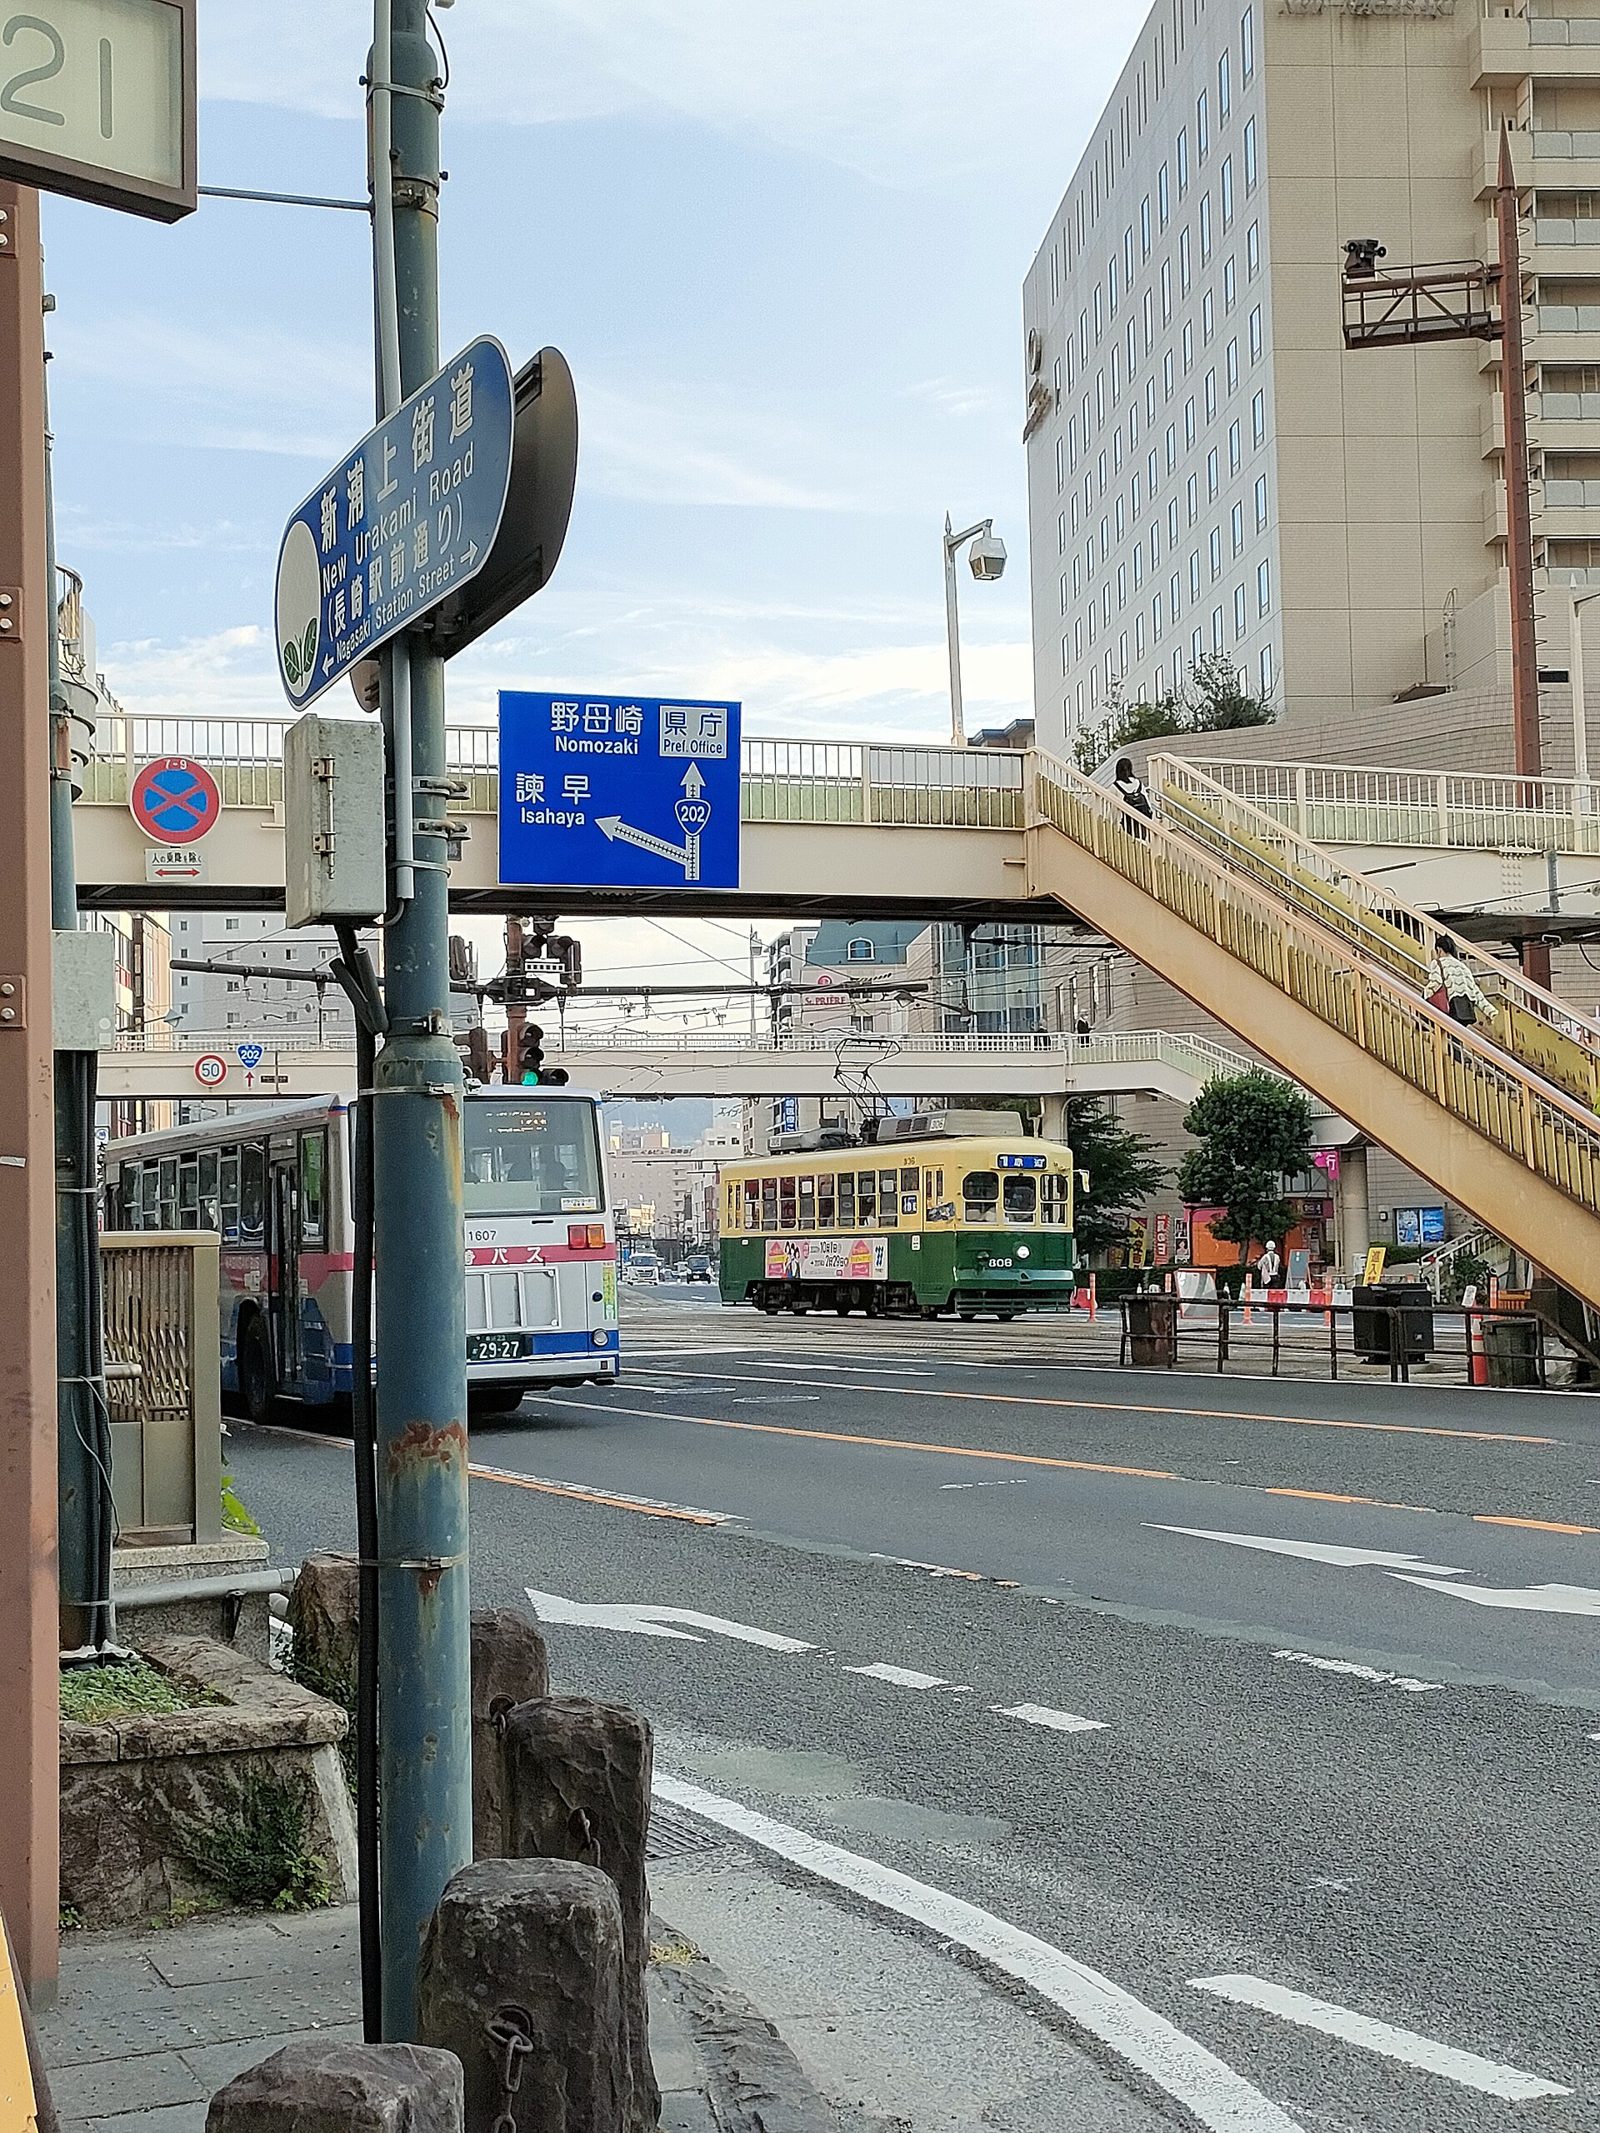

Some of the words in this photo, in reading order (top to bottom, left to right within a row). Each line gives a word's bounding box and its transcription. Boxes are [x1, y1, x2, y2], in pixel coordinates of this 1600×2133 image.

[1, 14, 113, 139] 21
[320, 362, 474, 555] 新浦上街道
[323, 553, 347, 598] New
[355, 487, 417, 566] Urakami
[429, 441, 473, 504] Road
[336, 614, 371, 664] Nagasaki
[375, 588, 413, 630] Station
[418, 556, 455, 598] Street
[551, 702, 644, 736] 野母崎
[664, 711, 723, 737] 県庁
[555, 735, 639, 755] Nomozaki
[516, 773, 591, 805] 諫早
[521, 807, 585, 828] Isahaya
[681, 806, 705, 823] 202
[241, 1050, 260, 1060] 202
[201, 1063, 220, 1077] 50
[468, 1231, 497, 1241] 1607
